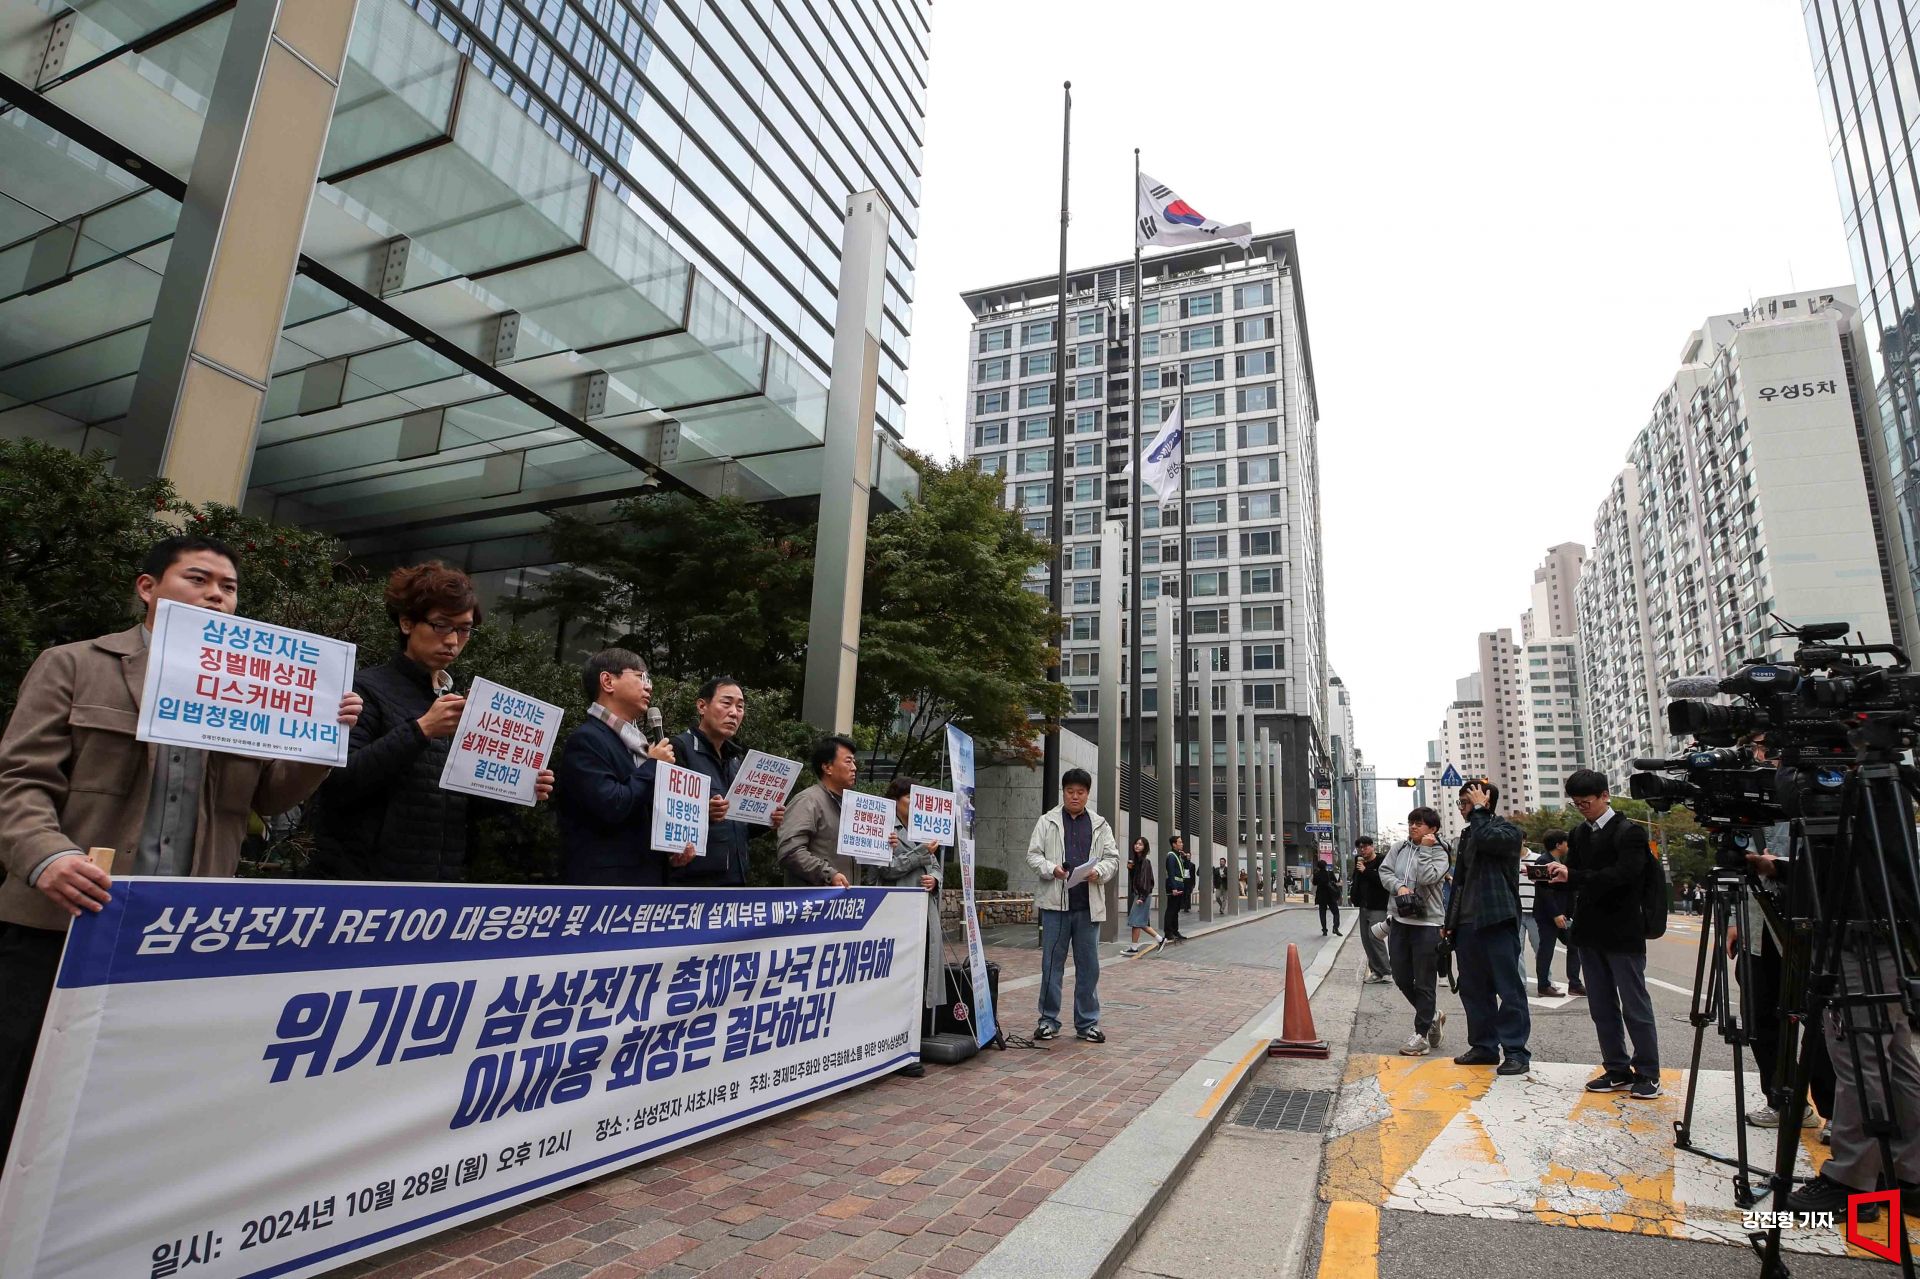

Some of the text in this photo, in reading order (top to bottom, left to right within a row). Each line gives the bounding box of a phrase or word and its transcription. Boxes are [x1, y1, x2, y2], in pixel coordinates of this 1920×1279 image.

[1758, 380, 1837, 401] 우성5차
[202, 619, 320, 664] 삼성전자는
[199, 647, 317, 690] 징벌배상과
[196, 674, 314, 717] 디스커버리
[491, 691, 545, 725] 삼성전자는
[158, 697, 339, 744] 입법청원에 나서라
[477, 711, 545, 748] 시스템반도체
[511, 746, 545, 770] 분사를
[756, 757, 791, 776] 삼성전자는
[474, 759, 521, 787] 결단하라
[669, 768, 701, 799] RE100
[746, 770, 788, 790] 시스템반도체
[667, 797, 700, 823] 대응방안
[739, 798, 768, 814] 결단하라
[856, 796, 886, 813] 삼성전자는
[915, 793, 952, 815] 재벌개혁
[853, 823, 884, 838] 디스커버리
[854, 810, 886, 826] 징벌배상과
[914, 813, 951, 835] 혁신성장
[665, 821, 699, 846] 발표하라
[136, 898, 866, 955] 삼성전자 RE100 대응방안 및 시스템반도체 설계부문 매각 촉구 기자회견
[262, 980, 477, 1084] 위기의
[476, 962, 663, 1050] 삼성전자
[667, 952, 760, 1017] 총체적
[760, 945, 816, 998] 난국
[816, 937, 895, 989] 타개위해
[449, 992, 836, 1130] 이재용 회장은 결단하라!
[150, 1230, 223, 1279] 일시:
[239, 1196, 335, 1250] 2024년
[346, 1179, 395, 1217] 10월
[402, 1164, 449, 1200] 28일
[455, 1153, 488, 1187] (월)
[496, 1141, 532, 1173] 오후
[538, 1129, 572, 1159] 12시
[634, 1098, 683, 1131] 삼성전자
[684, 1085, 727, 1114] 서초사옥
[729, 1081, 740, 1100] 앞
[750, 1072, 771, 1094] 주최:
[772, 1058, 820, 1087] 경제민주화와
[822, 1045, 863, 1072] 양극화해소를
[864, 1043, 876, 1058] 위한
